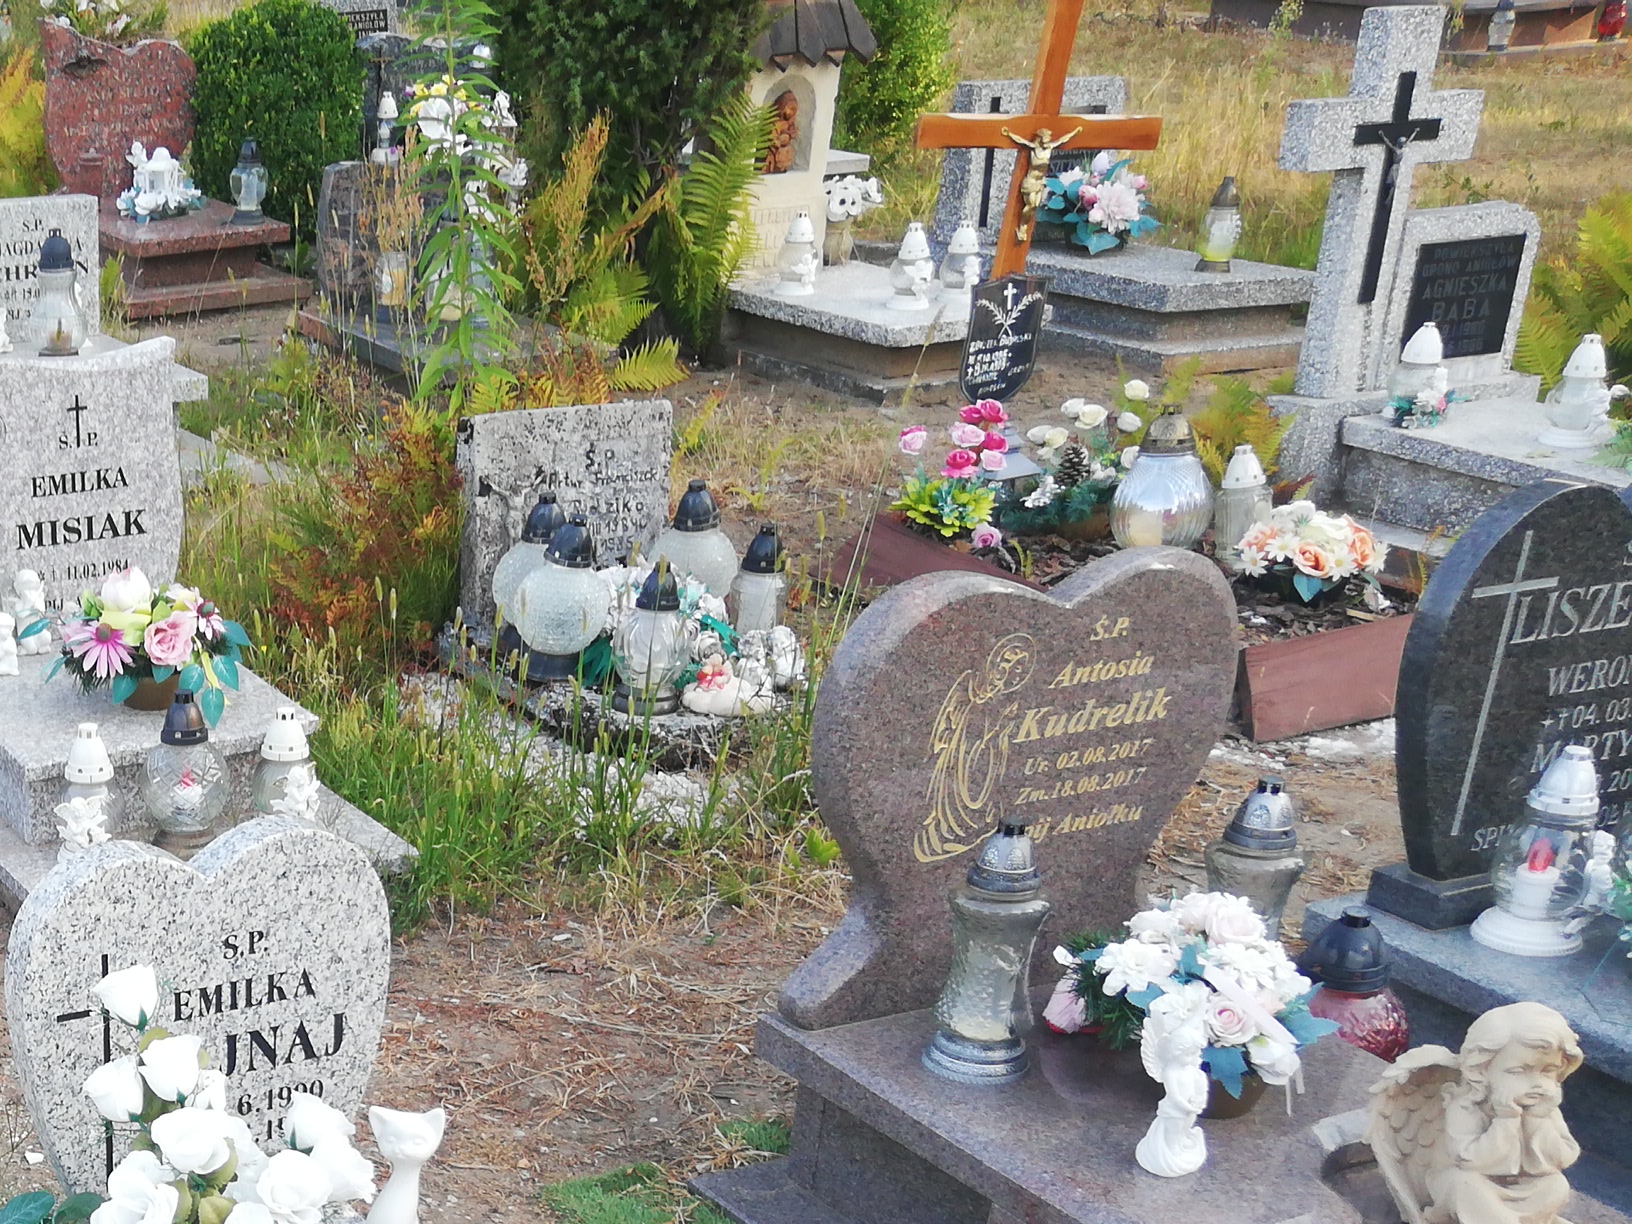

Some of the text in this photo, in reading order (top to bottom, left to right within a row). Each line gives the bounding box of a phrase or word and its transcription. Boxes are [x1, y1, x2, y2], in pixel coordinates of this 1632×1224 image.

[1422, 274, 1508, 300] AGNIESZKA
[1431, 299, 1490, 322] BABA
[31, 466, 130, 500] EMILKA
[16, 509, 148, 552] MISIAK
[1090, 615, 1132, 642] Ś.P.
[1509, 581, 1632, 645] LISZE
[1048, 651, 1156, 690] Antosia
[1012, 687, 1172, 744] Kudrelik
[1023, 739, 1152, 777] Ur. 02.08.2017
[1024, 801, 1144, 844] pij Aniołku
[172, 967, 317, 1023] EMILKA
[221, 1012, 345, 1078] JNAJ
